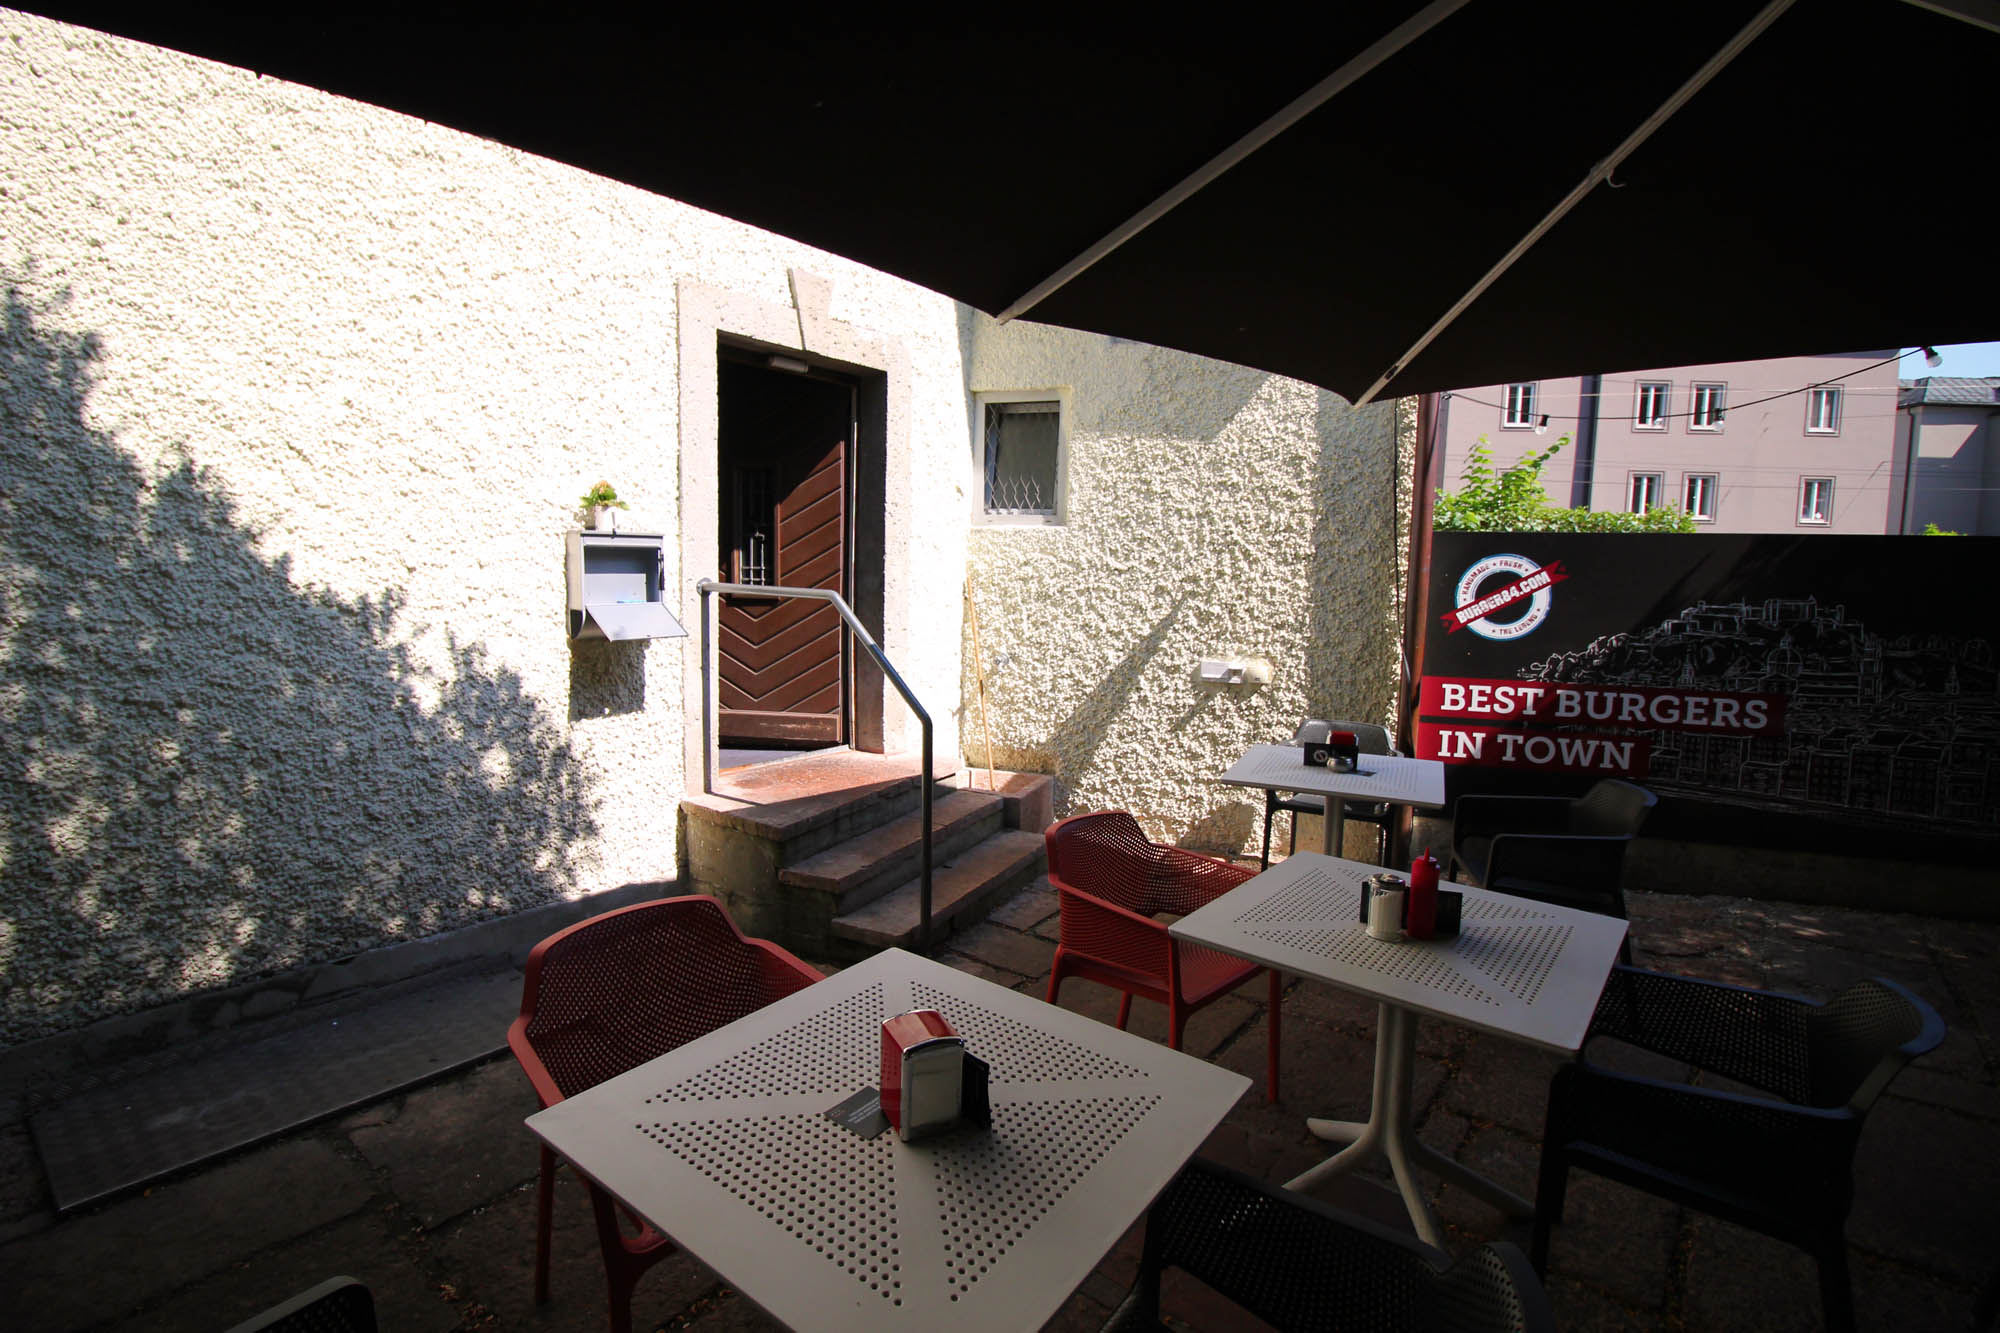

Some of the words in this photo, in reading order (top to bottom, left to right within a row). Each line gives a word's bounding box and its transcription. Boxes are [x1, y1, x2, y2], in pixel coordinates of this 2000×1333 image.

[1455, 571, 1551, 624] BURGER84.COM
[1462, 565, 1490, 595] HANDMADE
[1499, 560, 1523, 569] FRESH
[1441, 683, 1544, 716] BEST
[1554, 689, 1769, 729] BURGERS
[1437, 730, 1486, 759] IN
[1496, 733, 1635, 771] TOWN
